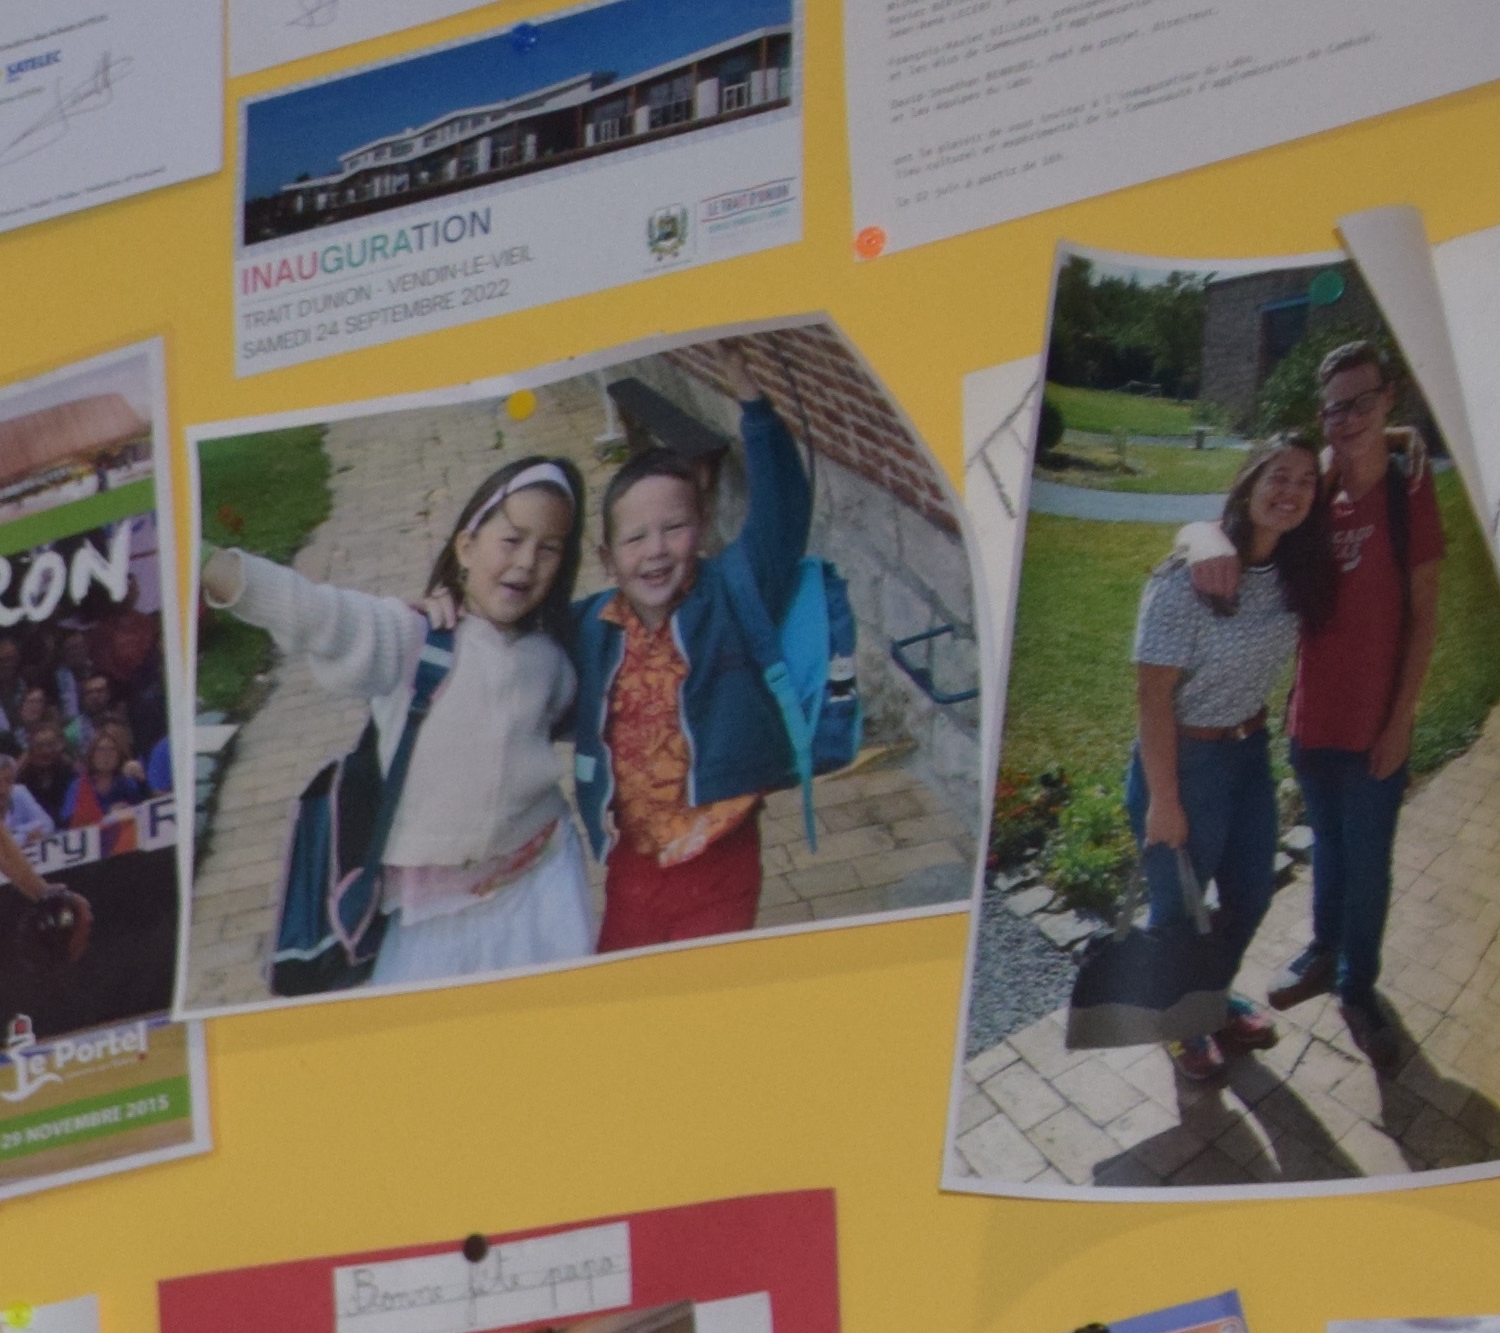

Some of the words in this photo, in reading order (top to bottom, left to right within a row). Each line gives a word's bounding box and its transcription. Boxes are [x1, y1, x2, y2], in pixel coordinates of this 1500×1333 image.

[6, 49, 63, 78] SATELEC
[240, 206, 494, 296] INAUGURATION
[242, 299, 295, 332] TRAIT
[385, 244, 535, 296] VENDIN-LE-VIEIL
[242, 326, 313, 362] SAMEDI
[317, 317, 340, 345] 24
[345, 290, 457, 337] SEPTEMBRE
[461, 278, 512, 310] 2022
[55, 1022, 149, 1069] Portel
[27, 1106, 124, 1143] NOVEMBRE
[125, 1093, 170, 1121] 2015
[346, 1267, 444, 1313] Bonne
[544, 1254, 624, 1308] papa
